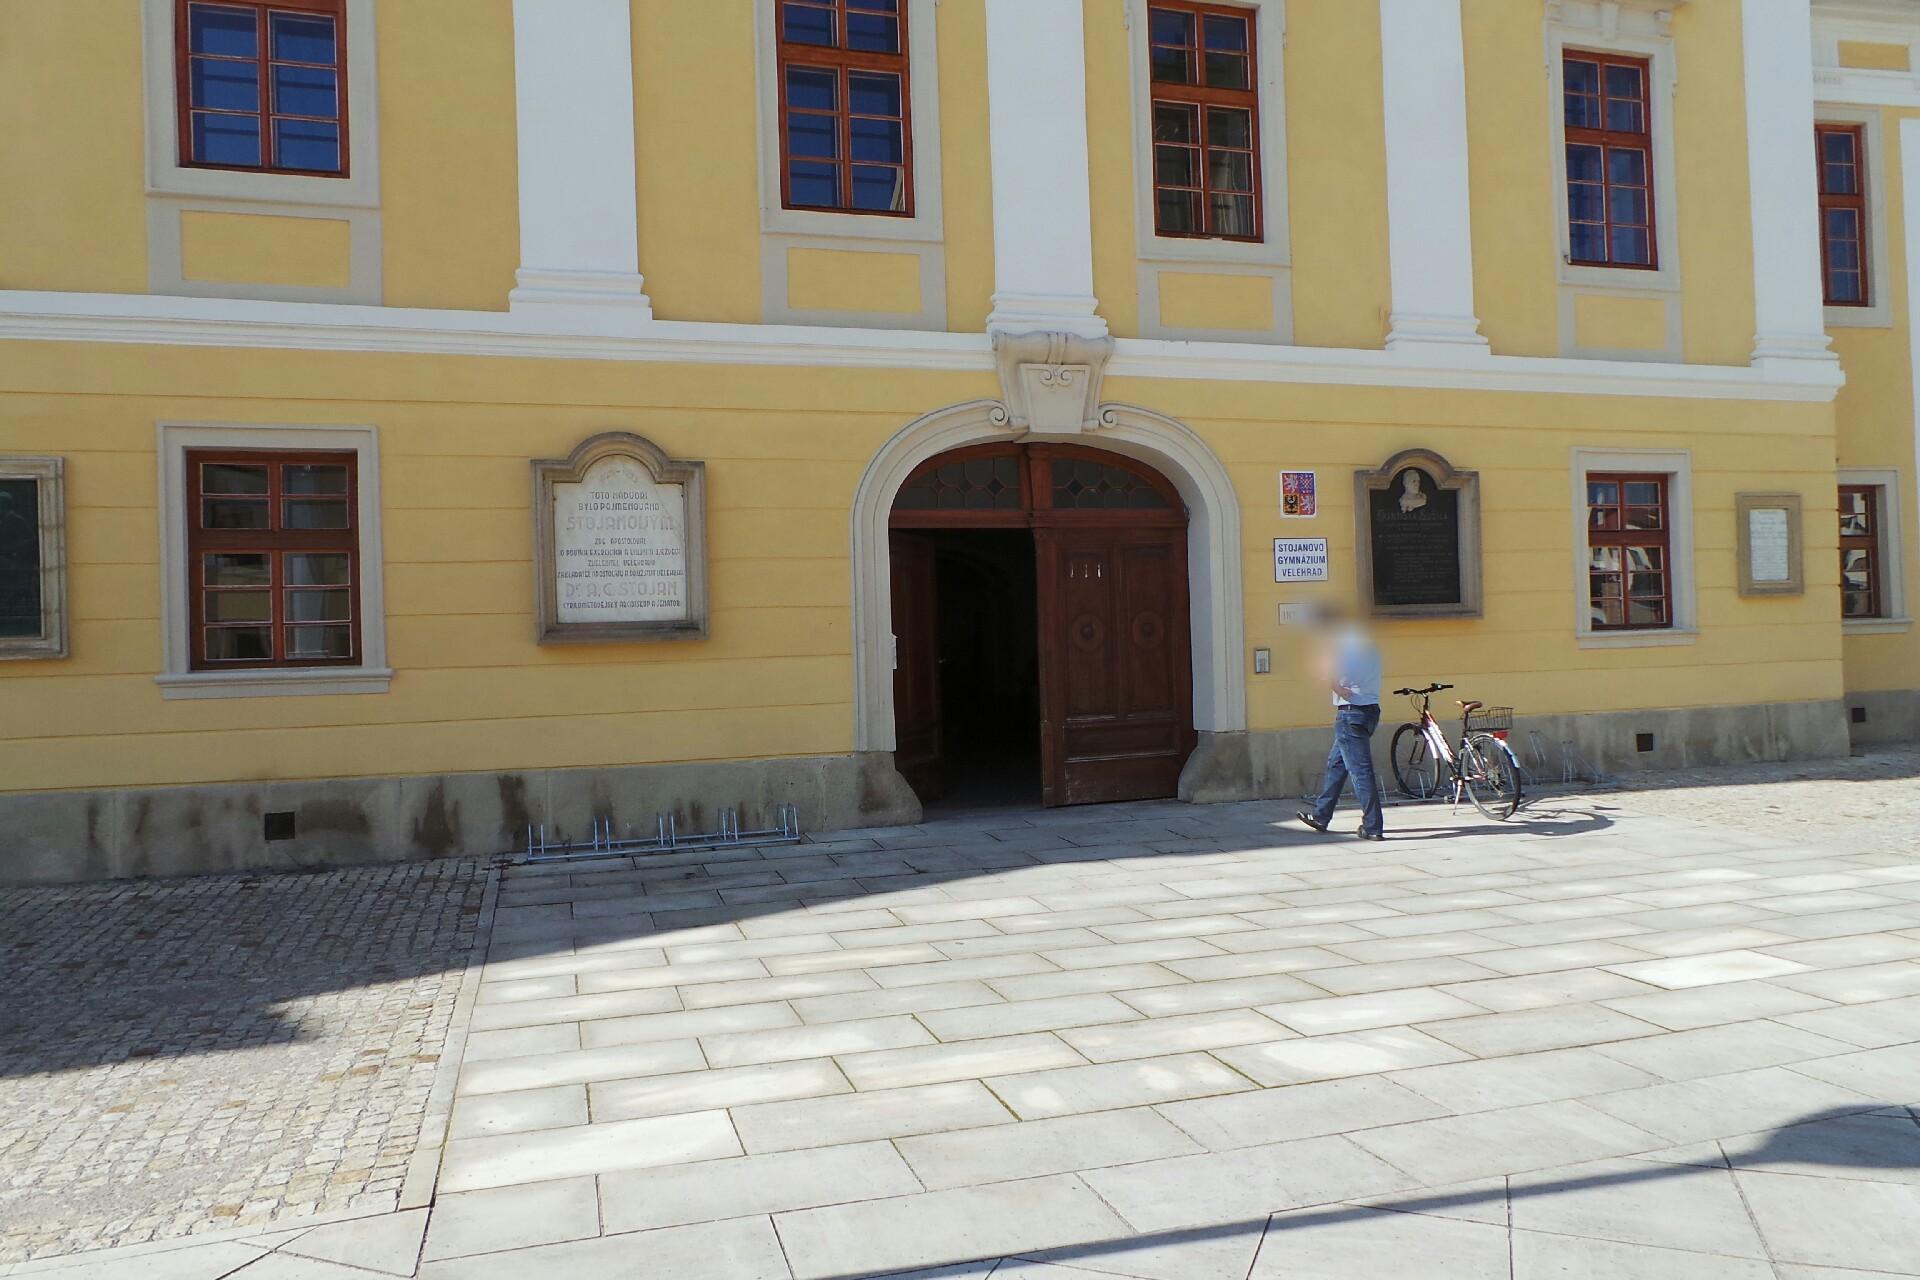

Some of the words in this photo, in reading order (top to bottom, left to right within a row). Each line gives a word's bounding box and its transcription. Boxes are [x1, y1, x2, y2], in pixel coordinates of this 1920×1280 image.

[591, 491, 610, 500] TOTO
[578, 502, 599, 511] BYLO
[1278, 543, 1324, 553] STOJANOVO
[1277, 555, 1326, 565] GYMNÁZIUM
[1282, 567, 1323, 577] VELEHRAD
[619, 581, 678, 597] STOJAN
